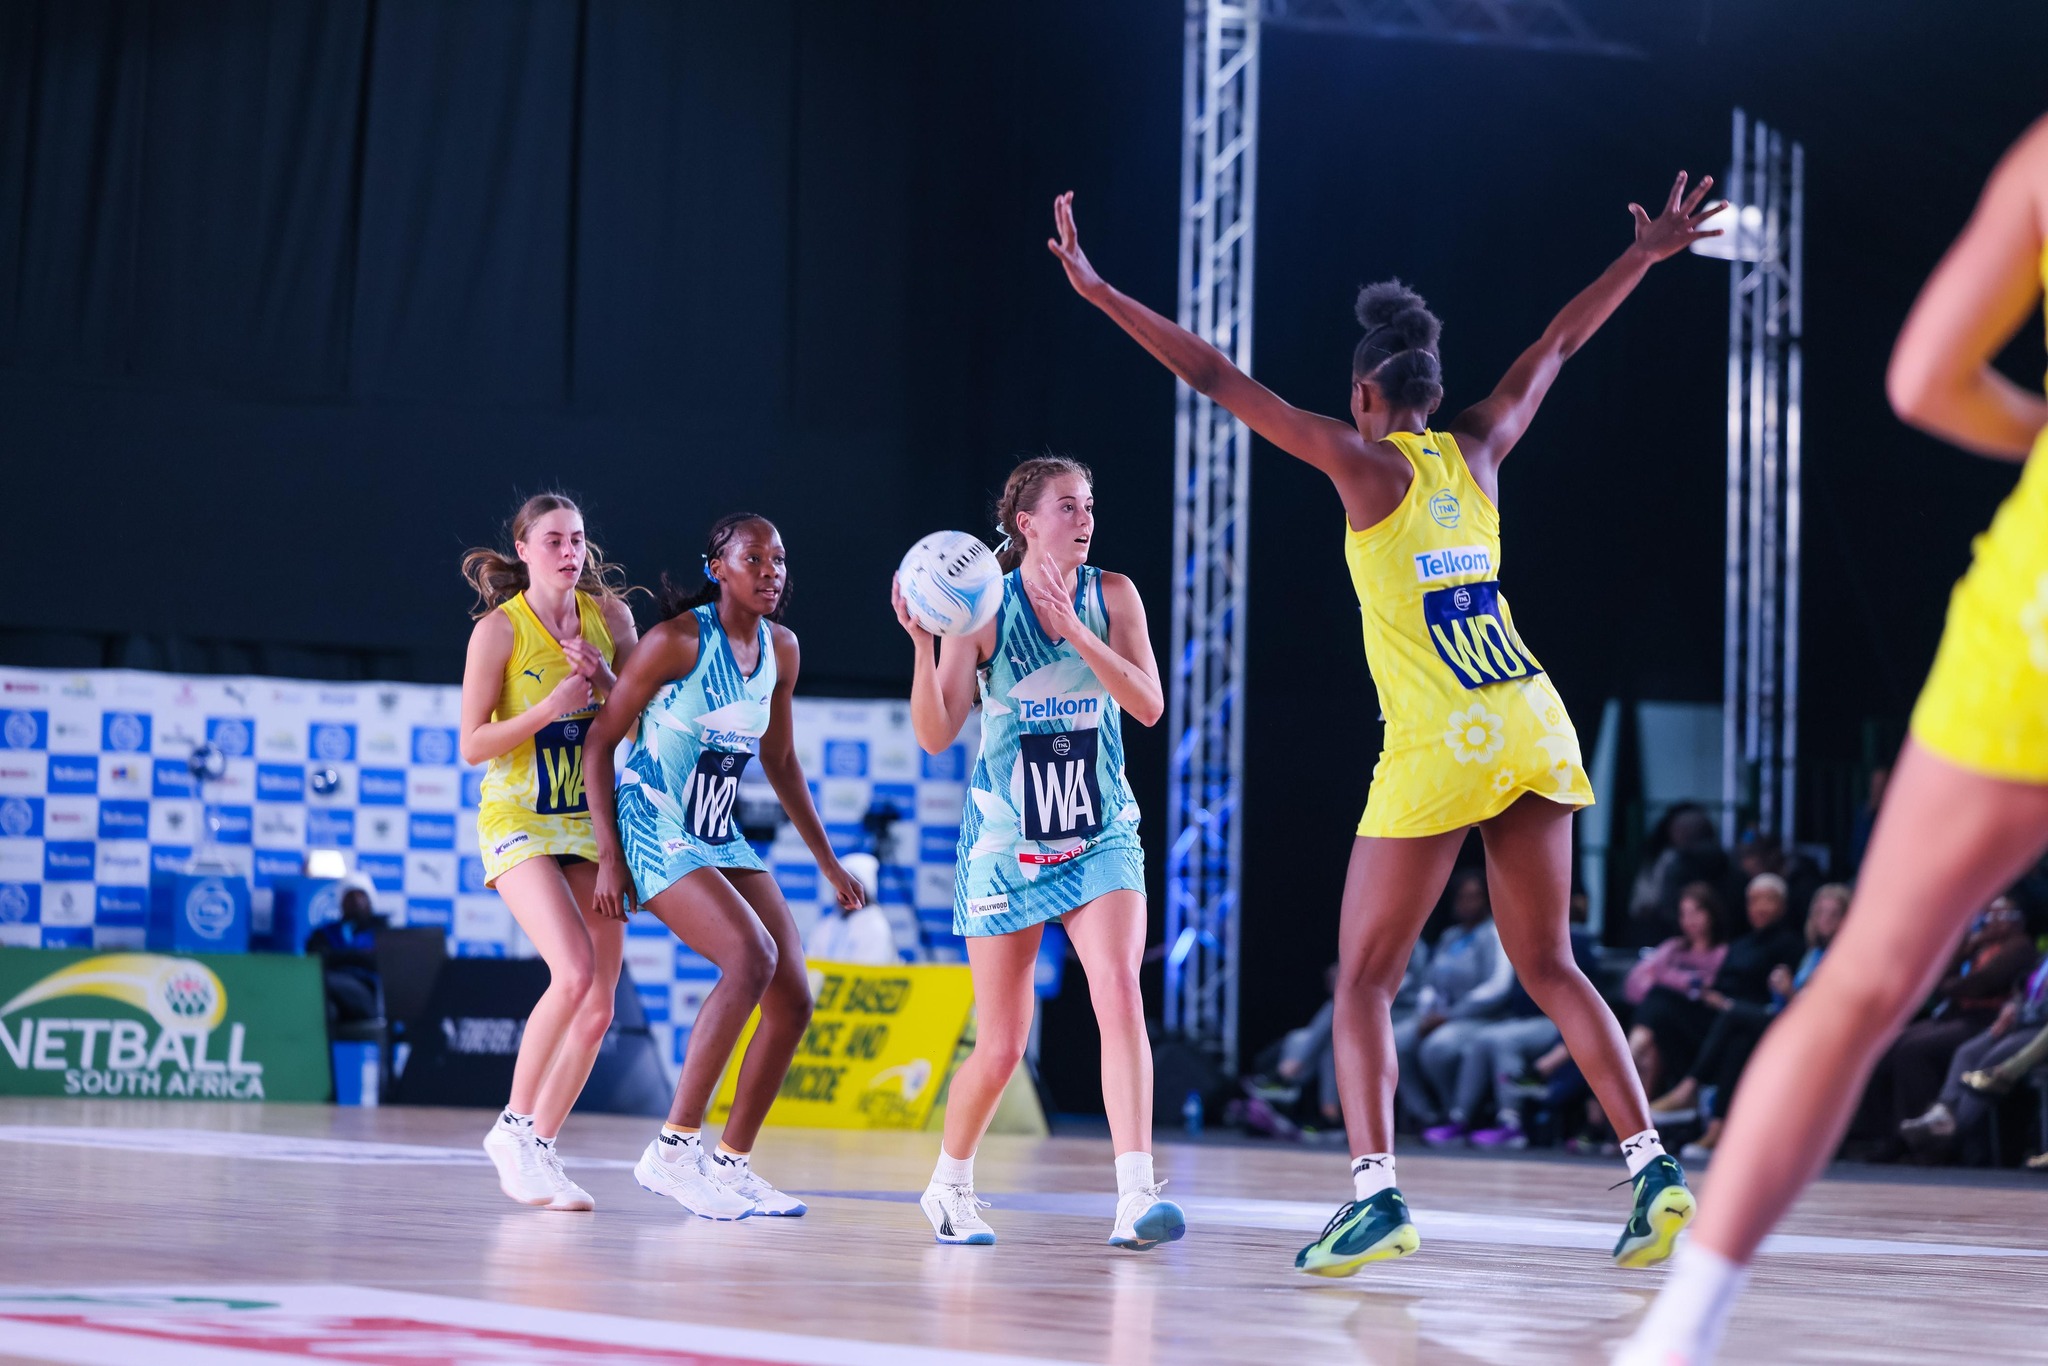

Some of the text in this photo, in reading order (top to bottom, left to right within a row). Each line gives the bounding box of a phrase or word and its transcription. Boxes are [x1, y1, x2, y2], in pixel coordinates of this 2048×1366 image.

[1437, 504, 1456, 515] TNL
[1415, 550, 1490, 578] Telkom
[1458, 595, 1469, 603] TNL
[1431, 613, 1527, 684] WD
[1020, 696, 1098, 719] Telkom
[693, 773, 738, 838] WD
[1030, 758, 1096, 833] WA
[1034, 846, 1083, 864] SPAR
[978, 901, 1008, 912] HOLLYWOOD
[0, 1017, 264, 1076] NETBALL
[64, 1068, 266, 1099] SOUTH AFRICA
